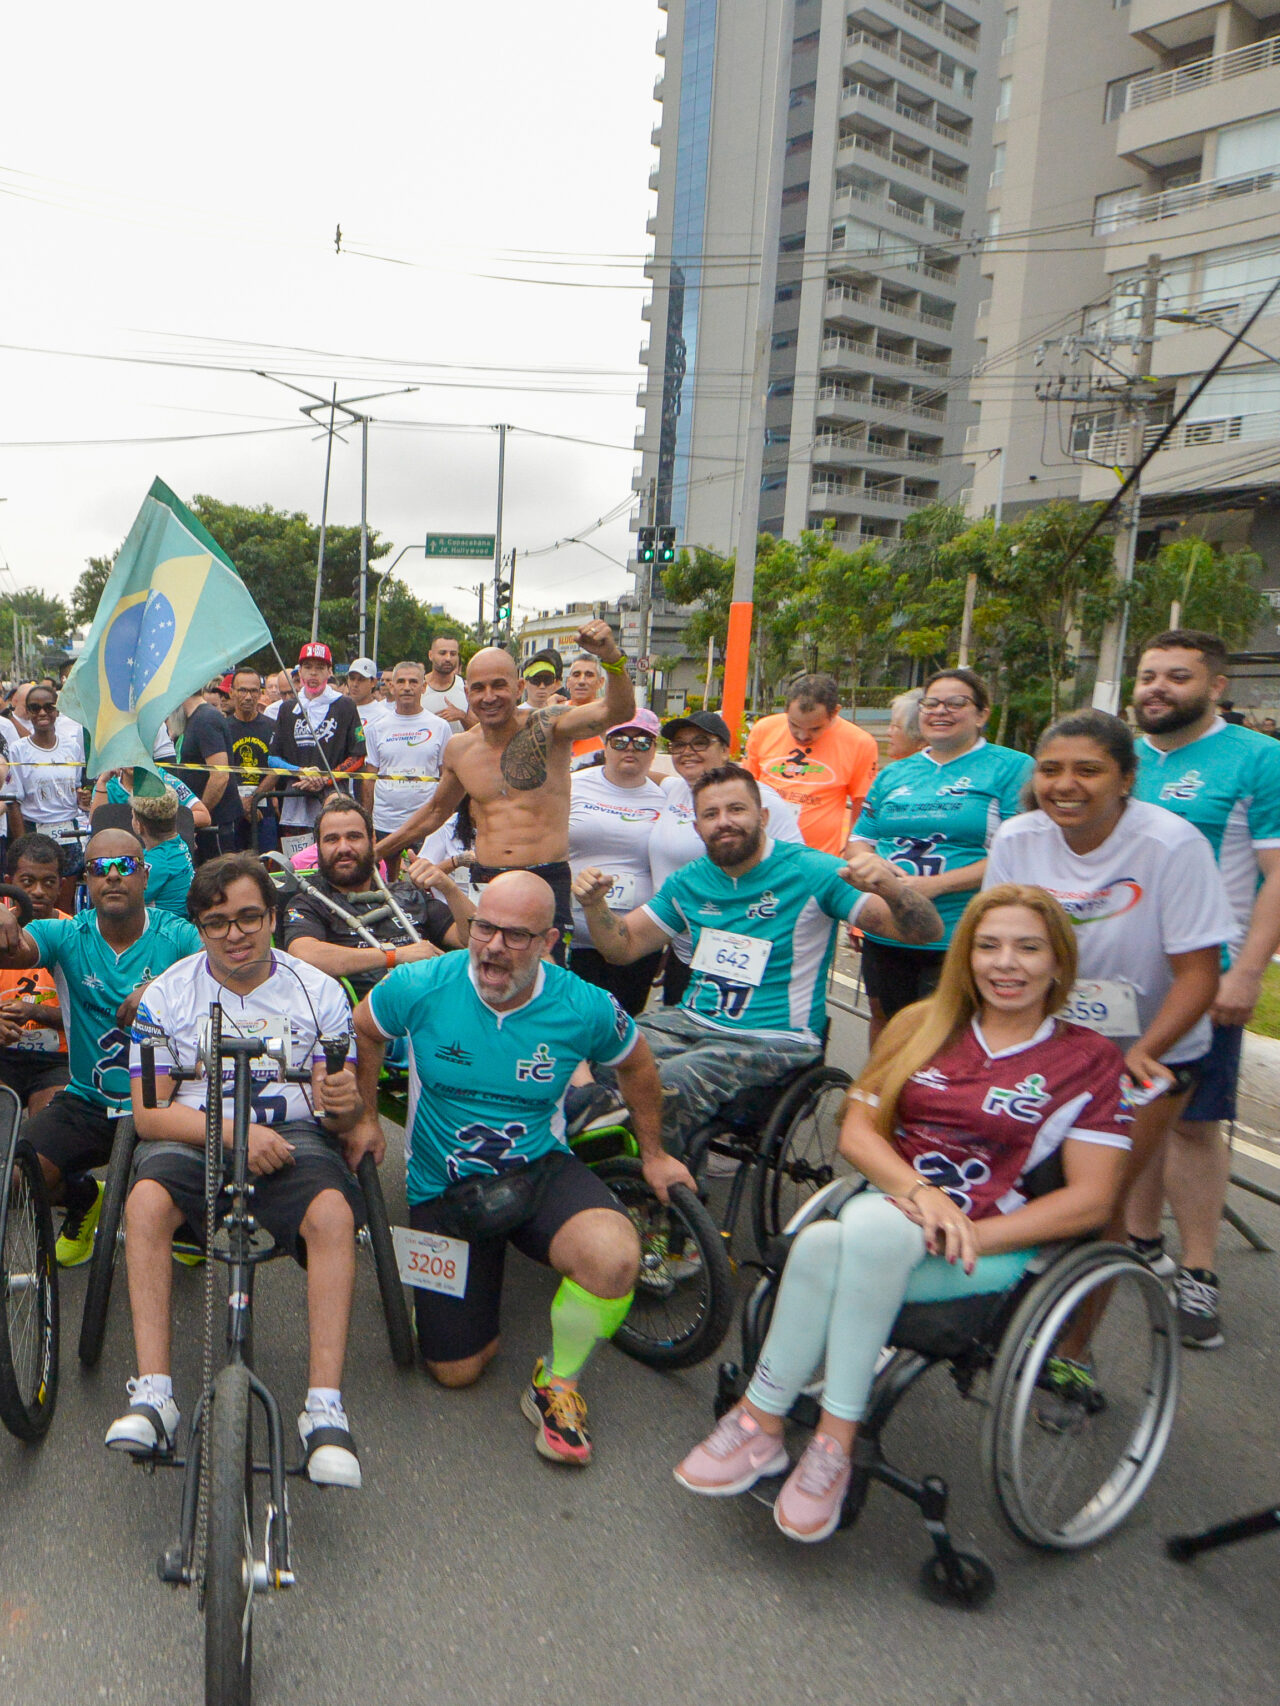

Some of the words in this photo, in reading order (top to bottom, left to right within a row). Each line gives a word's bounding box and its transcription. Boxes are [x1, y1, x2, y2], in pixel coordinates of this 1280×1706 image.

[451, 547, 489, 555] Hollywood
[605, 886, 625, 899] 97
[715, 948, 751, 970] 642
[407, 1250, 457, 1280] 3208
